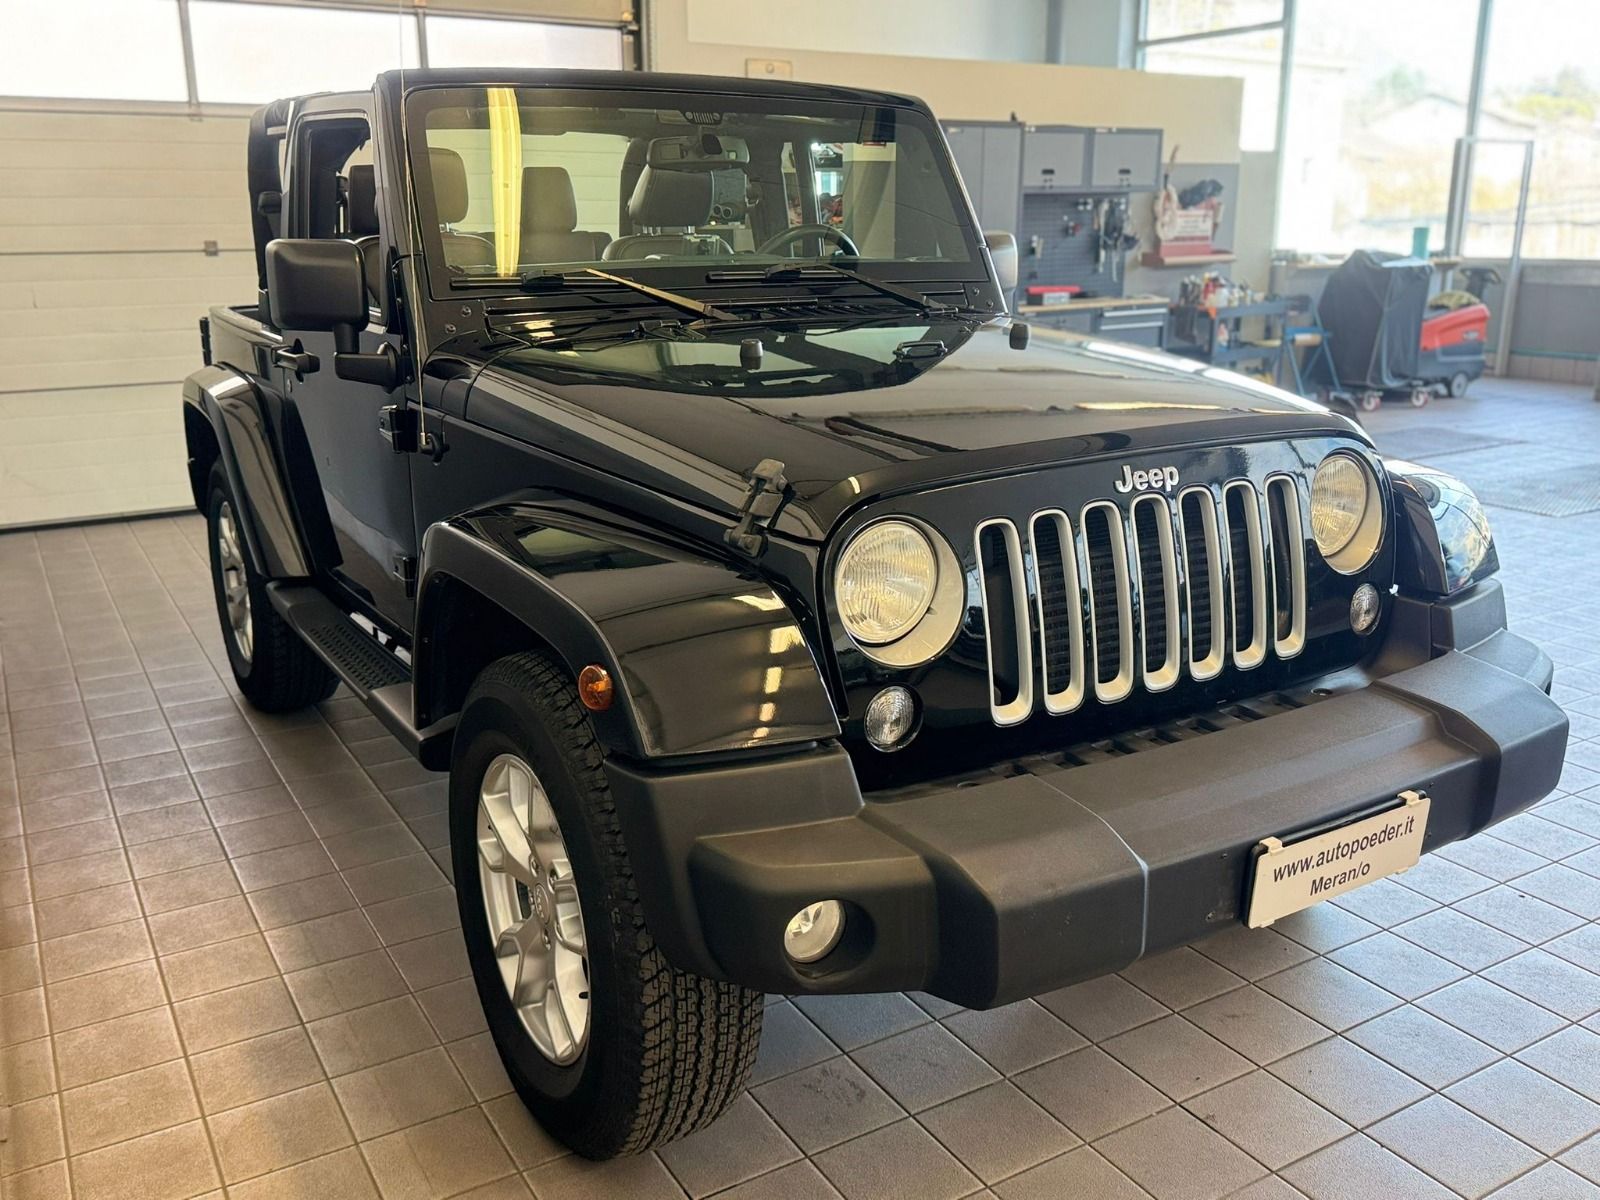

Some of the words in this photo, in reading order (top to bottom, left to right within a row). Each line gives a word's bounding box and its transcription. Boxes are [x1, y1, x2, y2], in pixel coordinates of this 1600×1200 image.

[1114, 465, 1179, 493] Jeep
[1273, 816, 1415, 883] www.autopoeder.it
[1309, 861, 1371, 896] Meran/o
